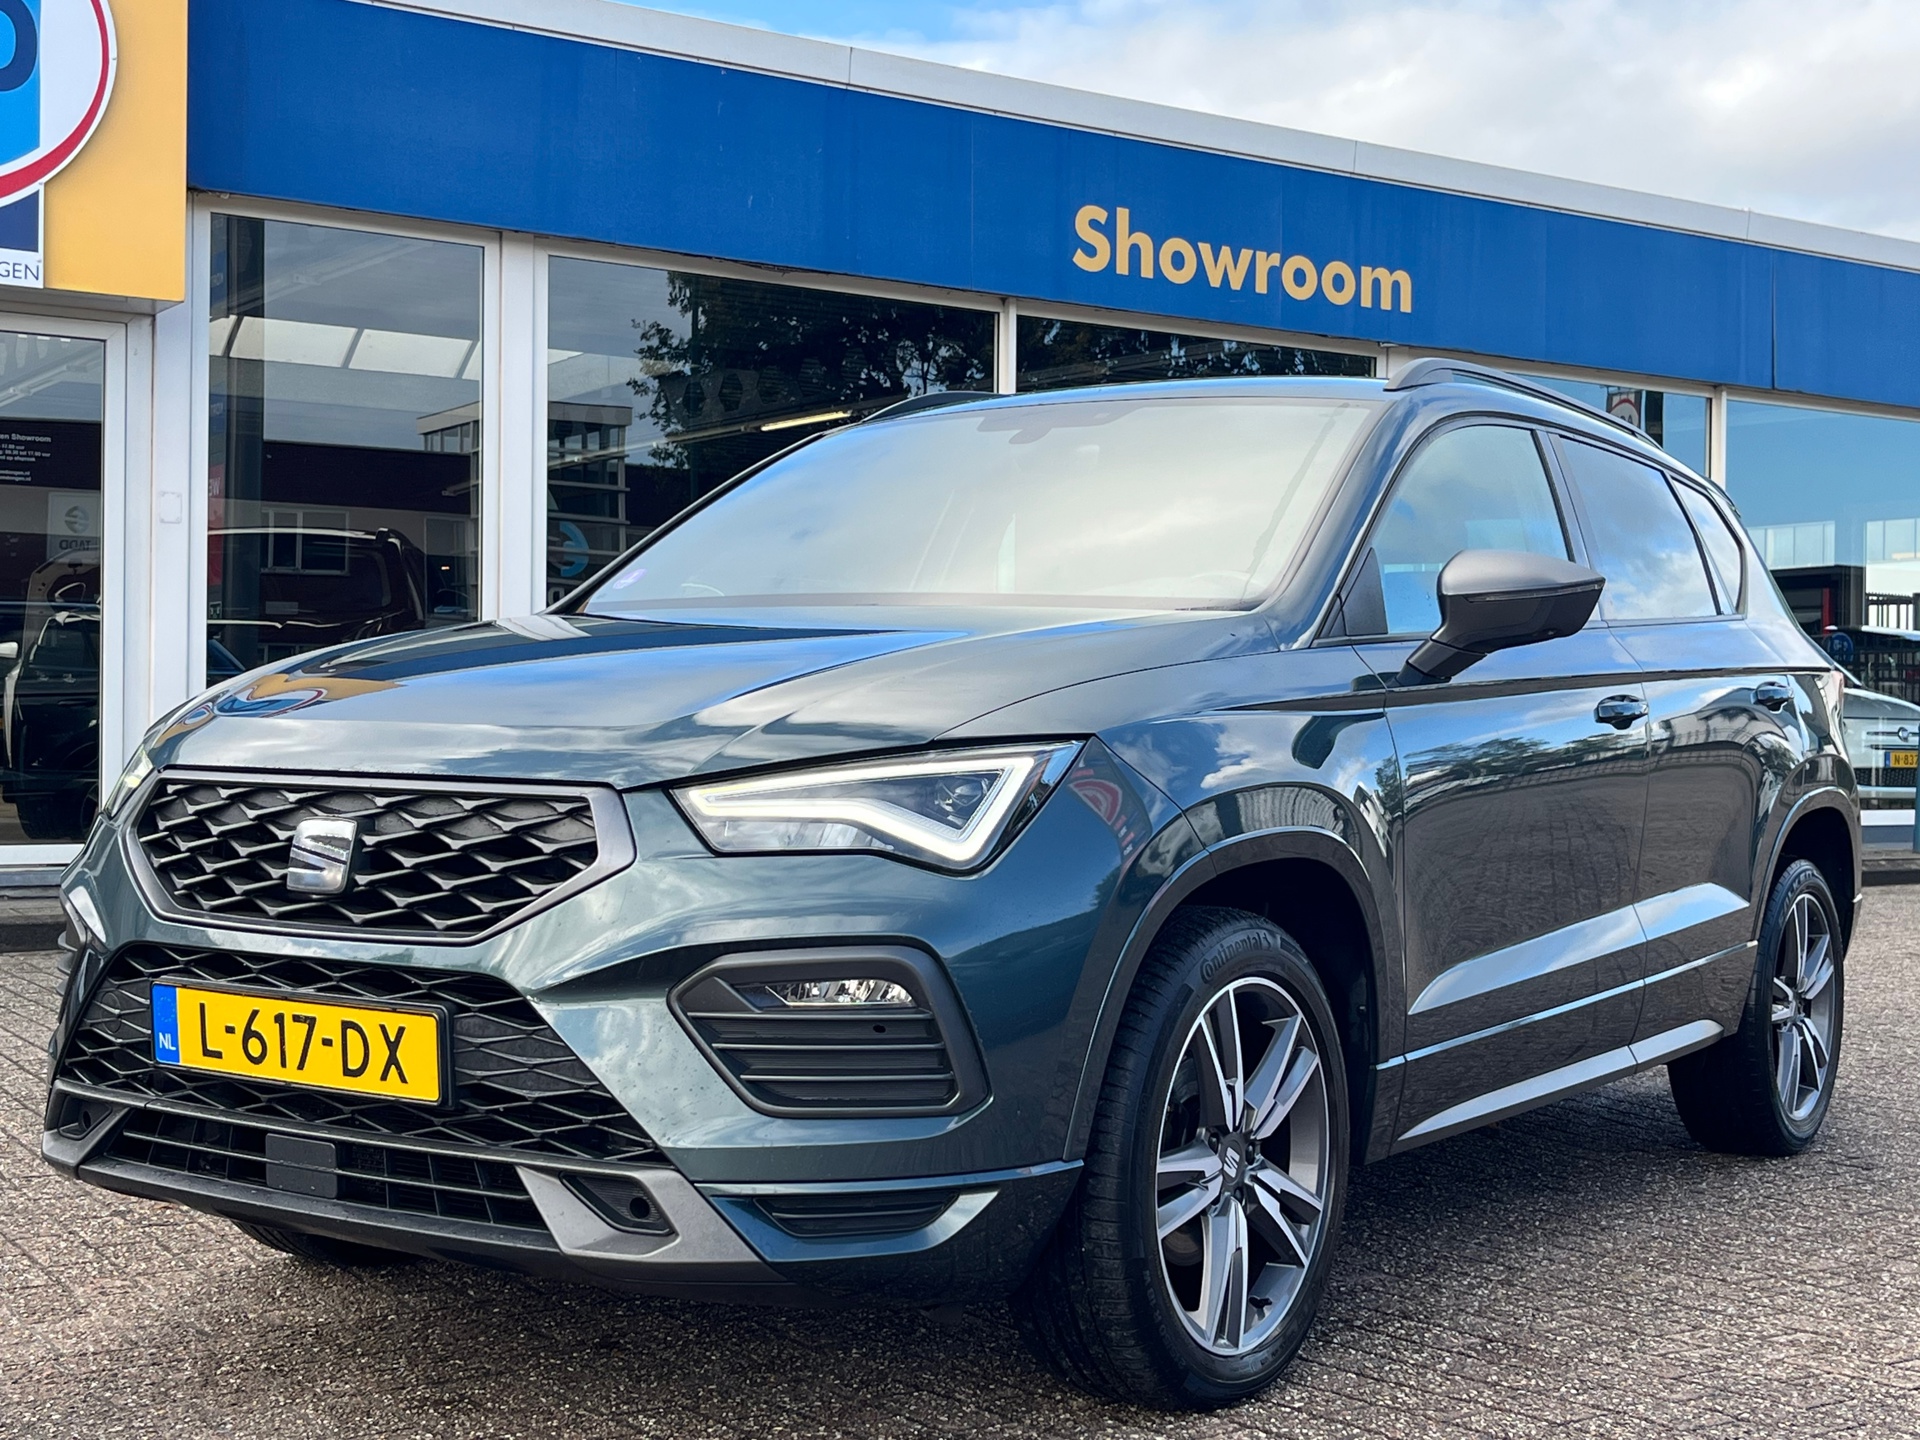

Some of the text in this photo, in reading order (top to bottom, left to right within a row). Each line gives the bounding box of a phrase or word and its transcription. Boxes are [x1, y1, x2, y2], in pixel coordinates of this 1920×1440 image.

[1072, 204, 1412, 313] Showroom
[11, 433, 52, 442] Showroom
[1200, 931, 1263, 984] Continental
[159, 1032, 177, 1051] NL
[200, 1002, 408, 1084] L-617-DX
